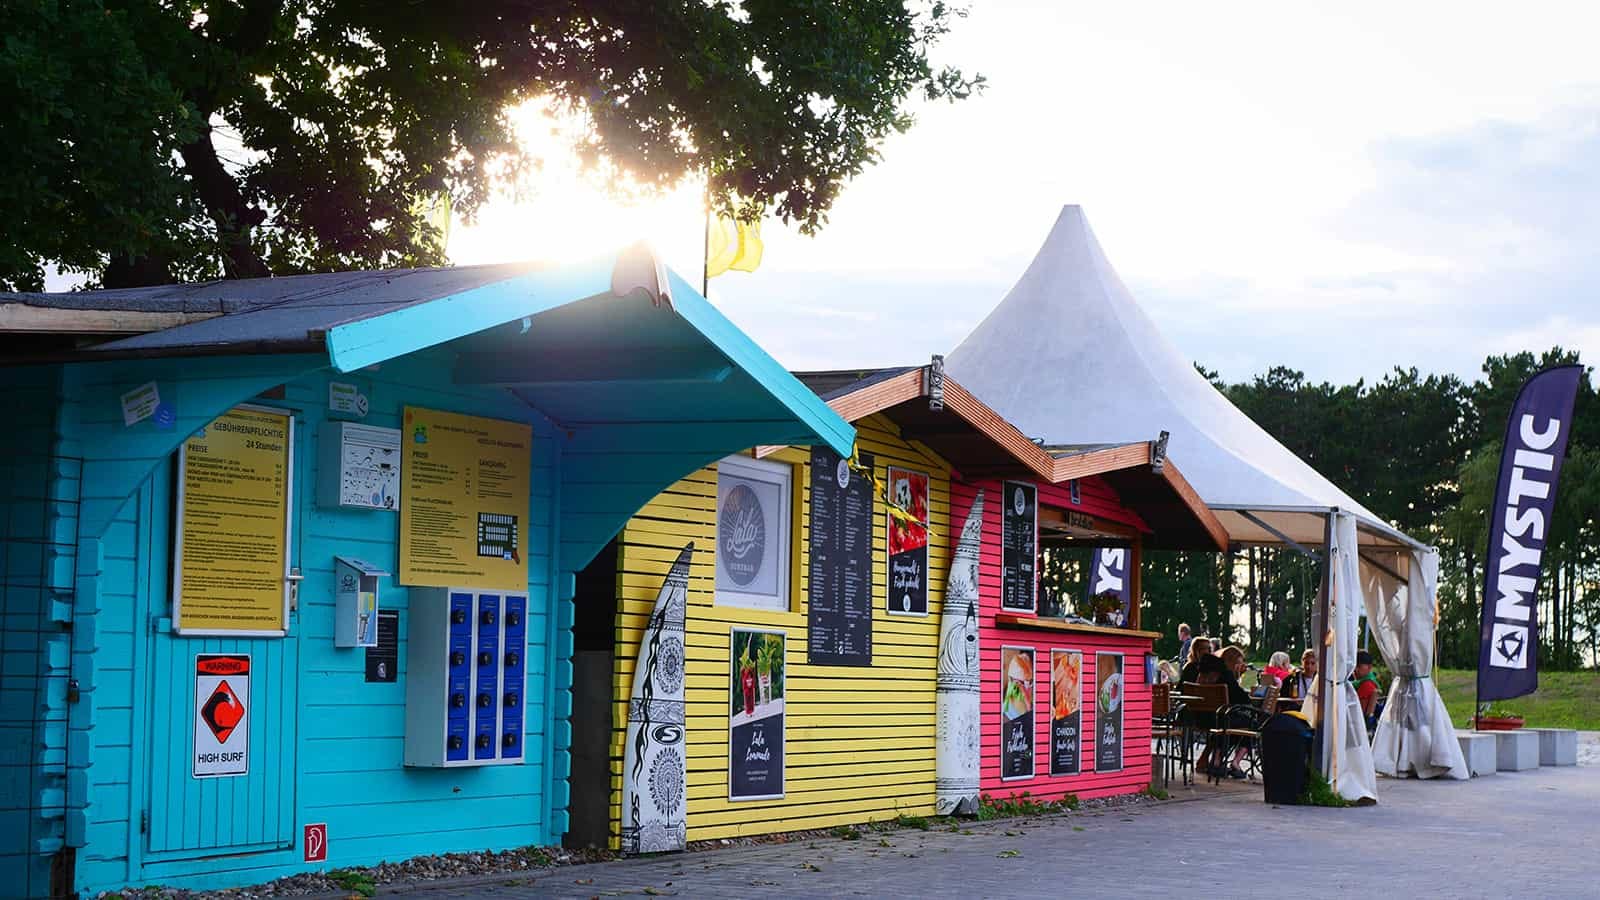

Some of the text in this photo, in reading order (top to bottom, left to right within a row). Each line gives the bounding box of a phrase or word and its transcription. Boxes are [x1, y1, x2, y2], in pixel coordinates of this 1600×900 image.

[213, 422, 284, 439] GEBÜHRENPFLICHTIG
[255, 441, 282, 451] Stunden
[1495, 414, 1560, 621] MYSTIC
[205, 662, 242, 672] WARNING
[197, 752, 244, 764] HIGH SURF
